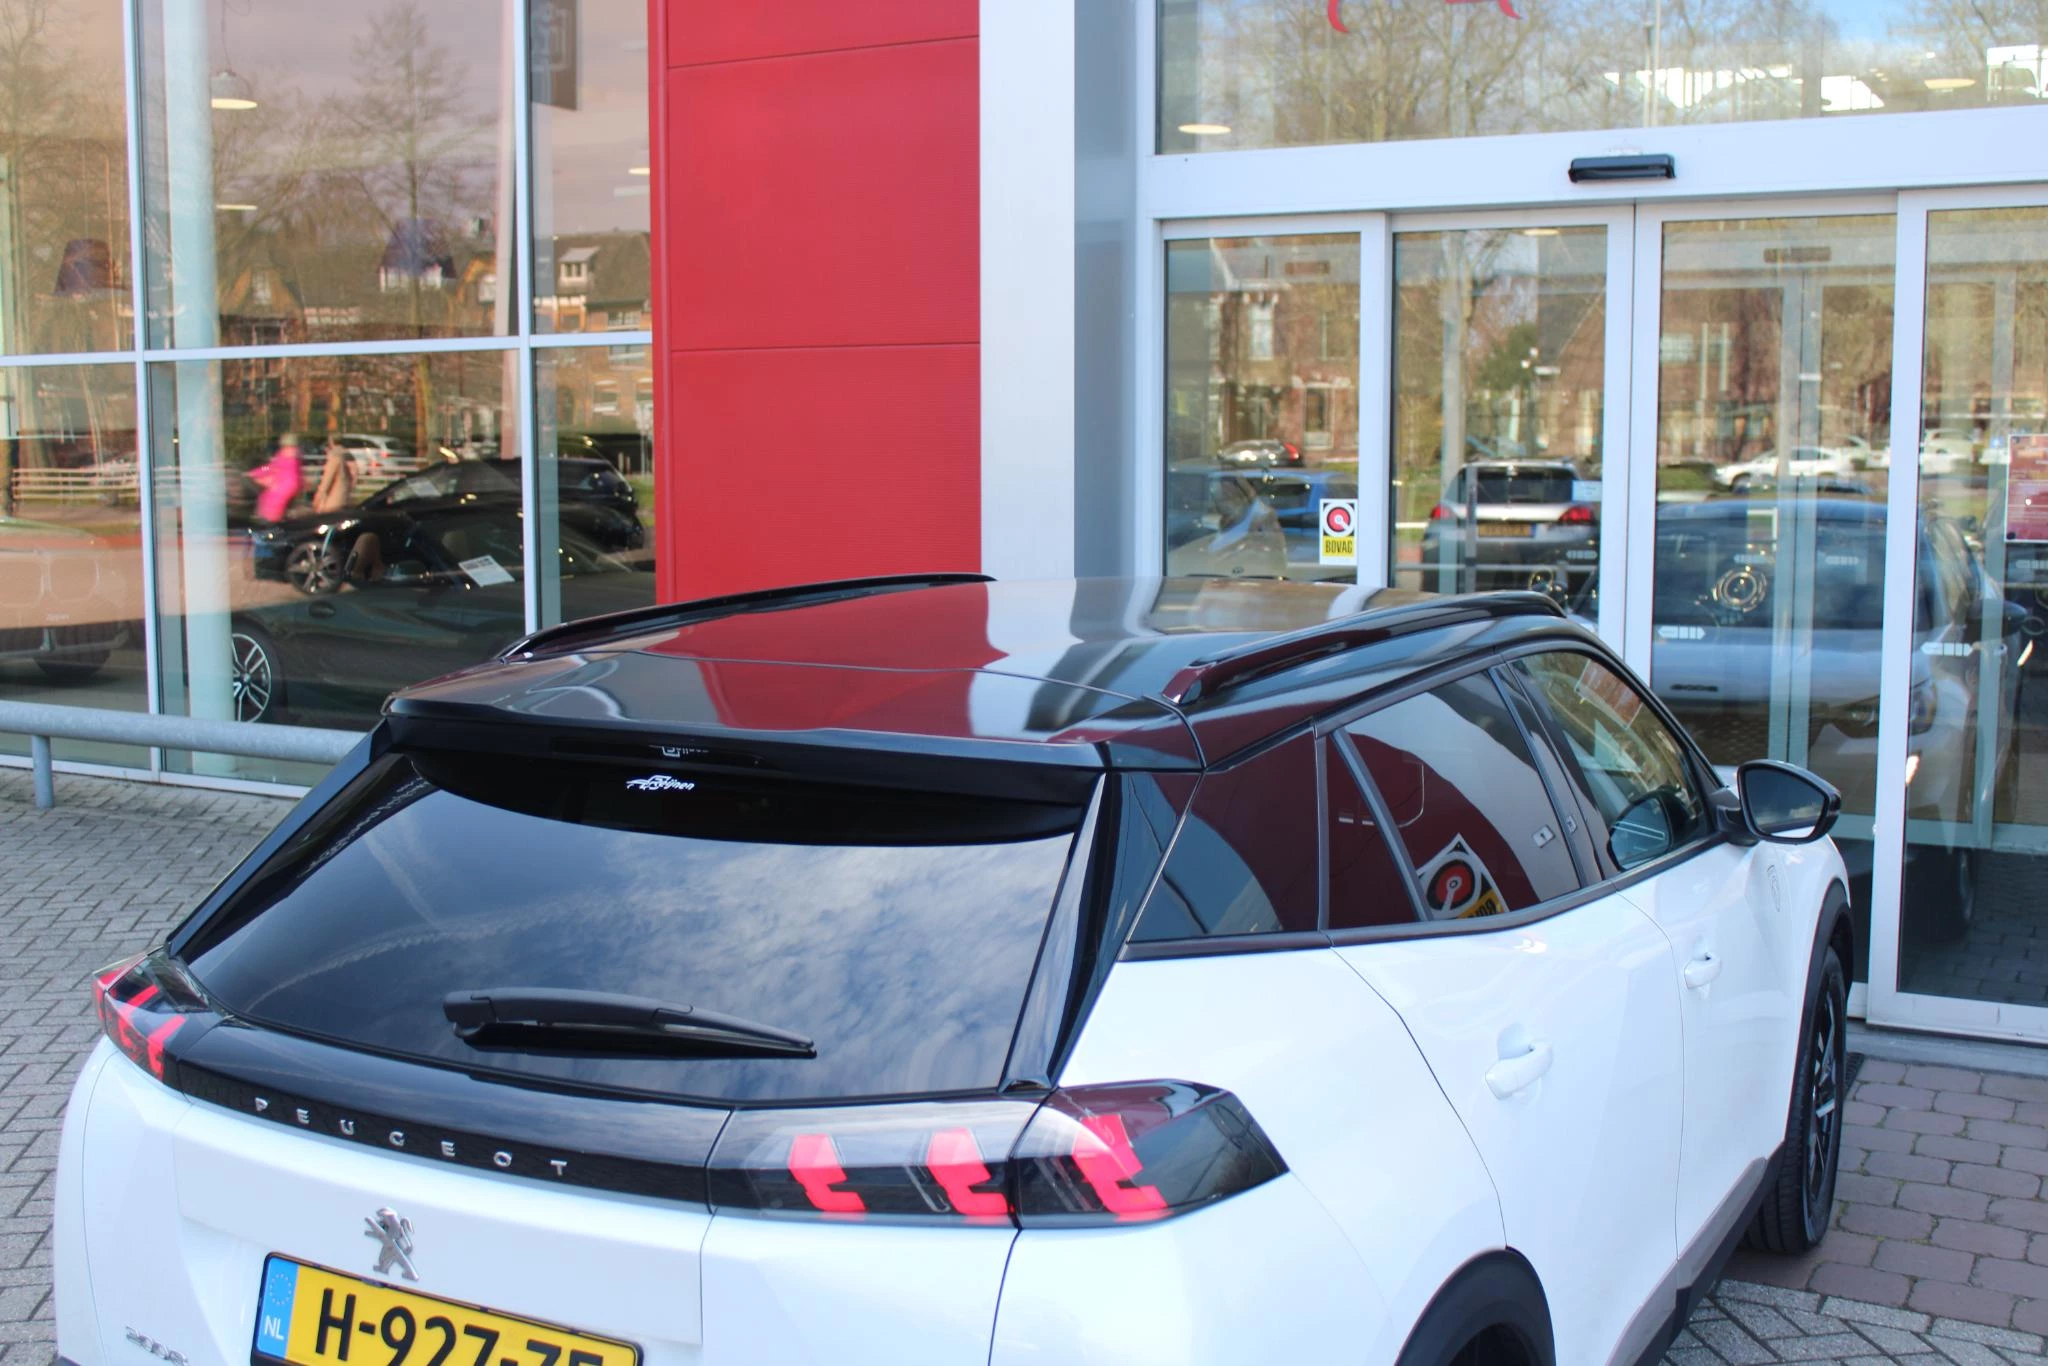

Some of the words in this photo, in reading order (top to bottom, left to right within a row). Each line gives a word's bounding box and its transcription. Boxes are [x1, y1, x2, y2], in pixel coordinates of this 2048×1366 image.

[1325, 539, 1353, 554] BOVAG
[253, 1096, 568, 1176] PEUGEOT
[263, 1314, 285, 1341] NL
[315, 1287, 604, 1366] H-927-
